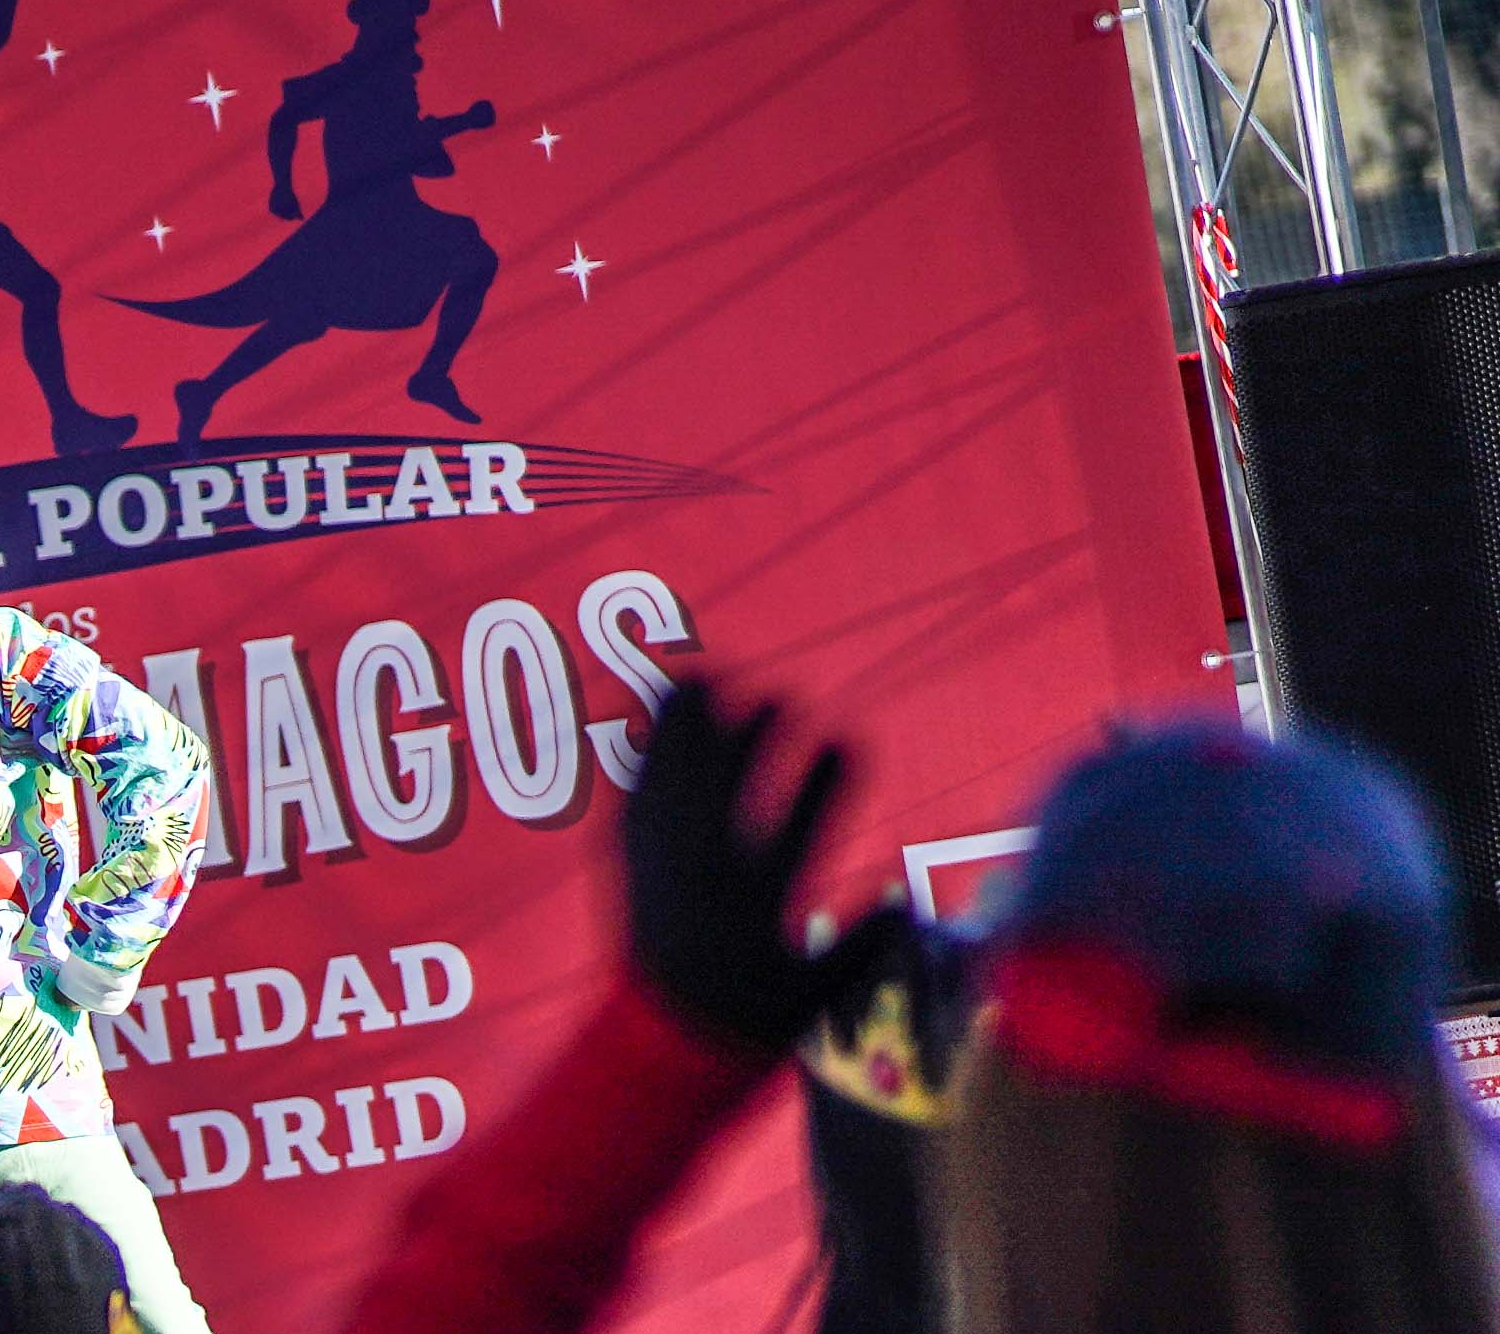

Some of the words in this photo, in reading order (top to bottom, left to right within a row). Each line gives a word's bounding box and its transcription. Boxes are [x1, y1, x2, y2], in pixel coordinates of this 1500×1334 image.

[28, 442, 536, 560] POPULAR
[90, 941, 473, 1071] NIDAD
[114, 1076, 467, 1197] ADRID
